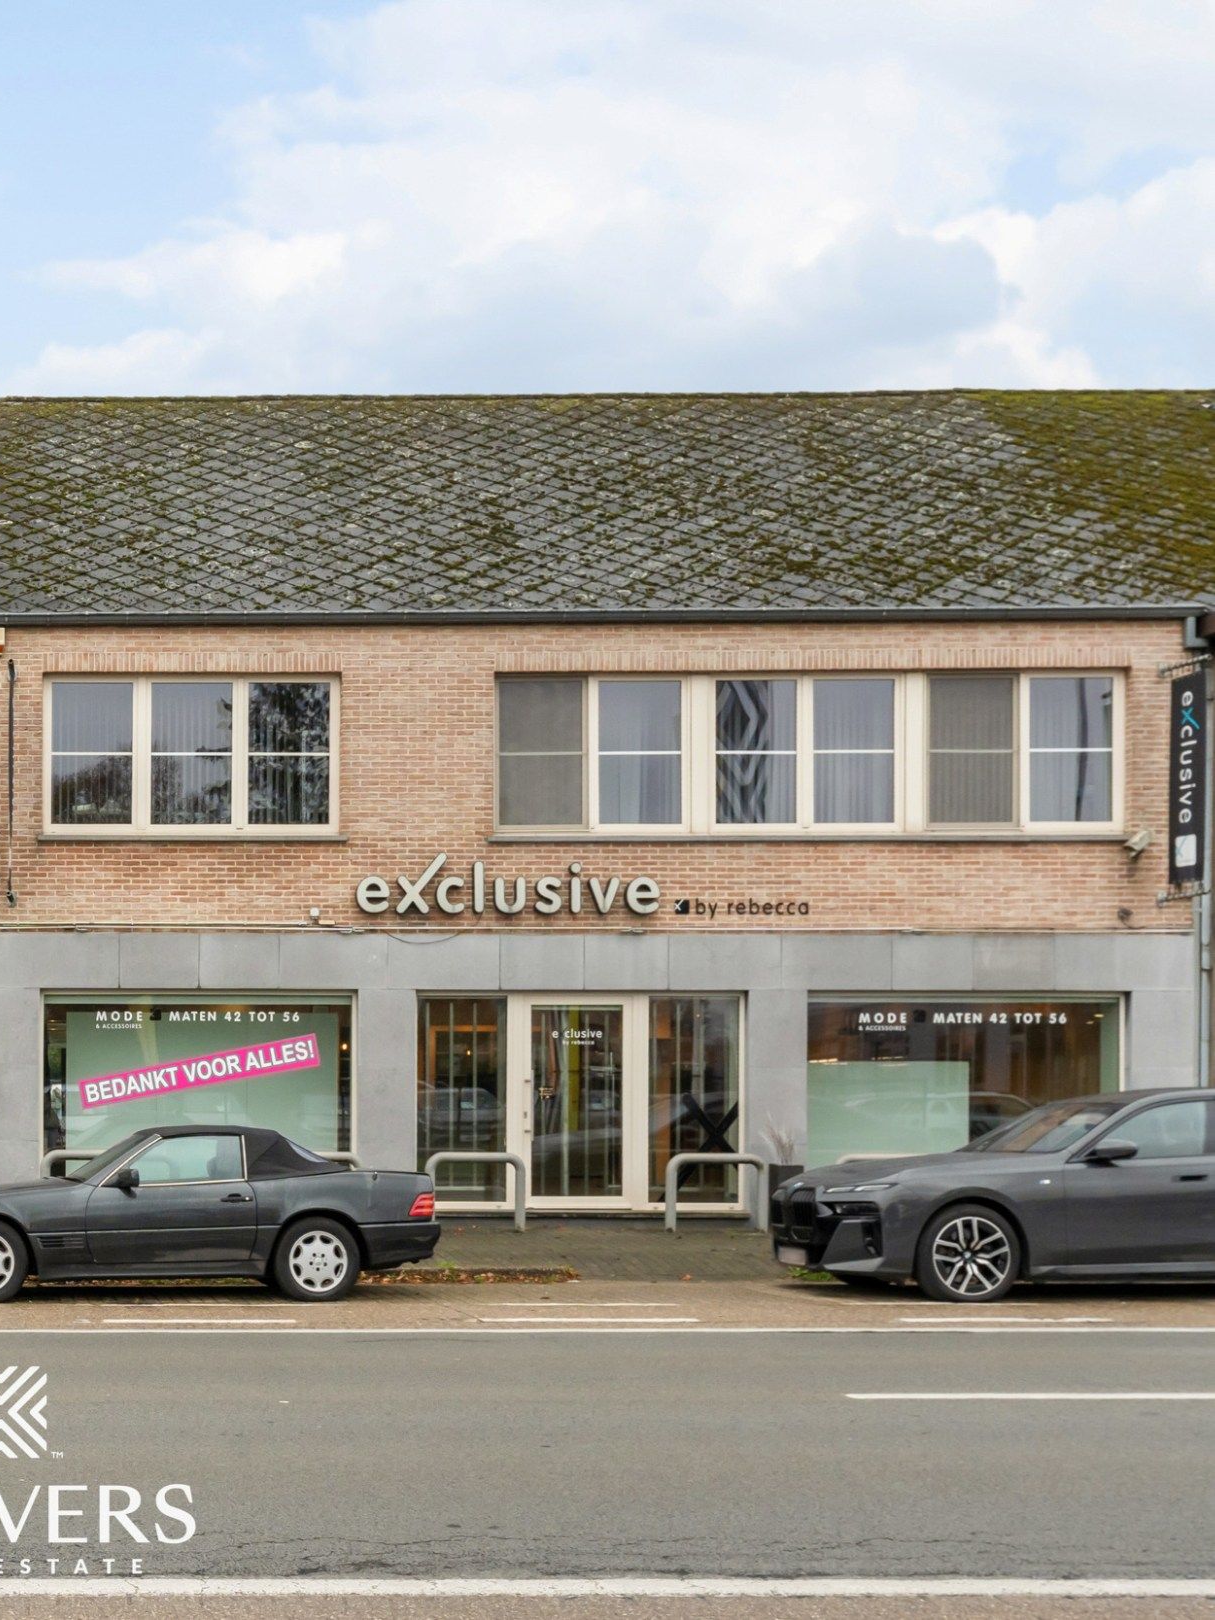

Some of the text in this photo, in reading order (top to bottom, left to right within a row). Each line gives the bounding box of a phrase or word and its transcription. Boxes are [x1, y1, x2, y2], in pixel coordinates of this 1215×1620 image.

[1178, 690, 1200, 824] exclusive
[356, 852, 661, 914] exclusive
[695, 898, 809, 920] by rebecca
[96, 1010, 300, 1022] MODE MATEN 42 TOT 56
[858, 1012, 1067, 1024] MODE MATEN 42 TOT 56
[84, 1040, 315, 1103] BEDANKT VOOR ALLES!
